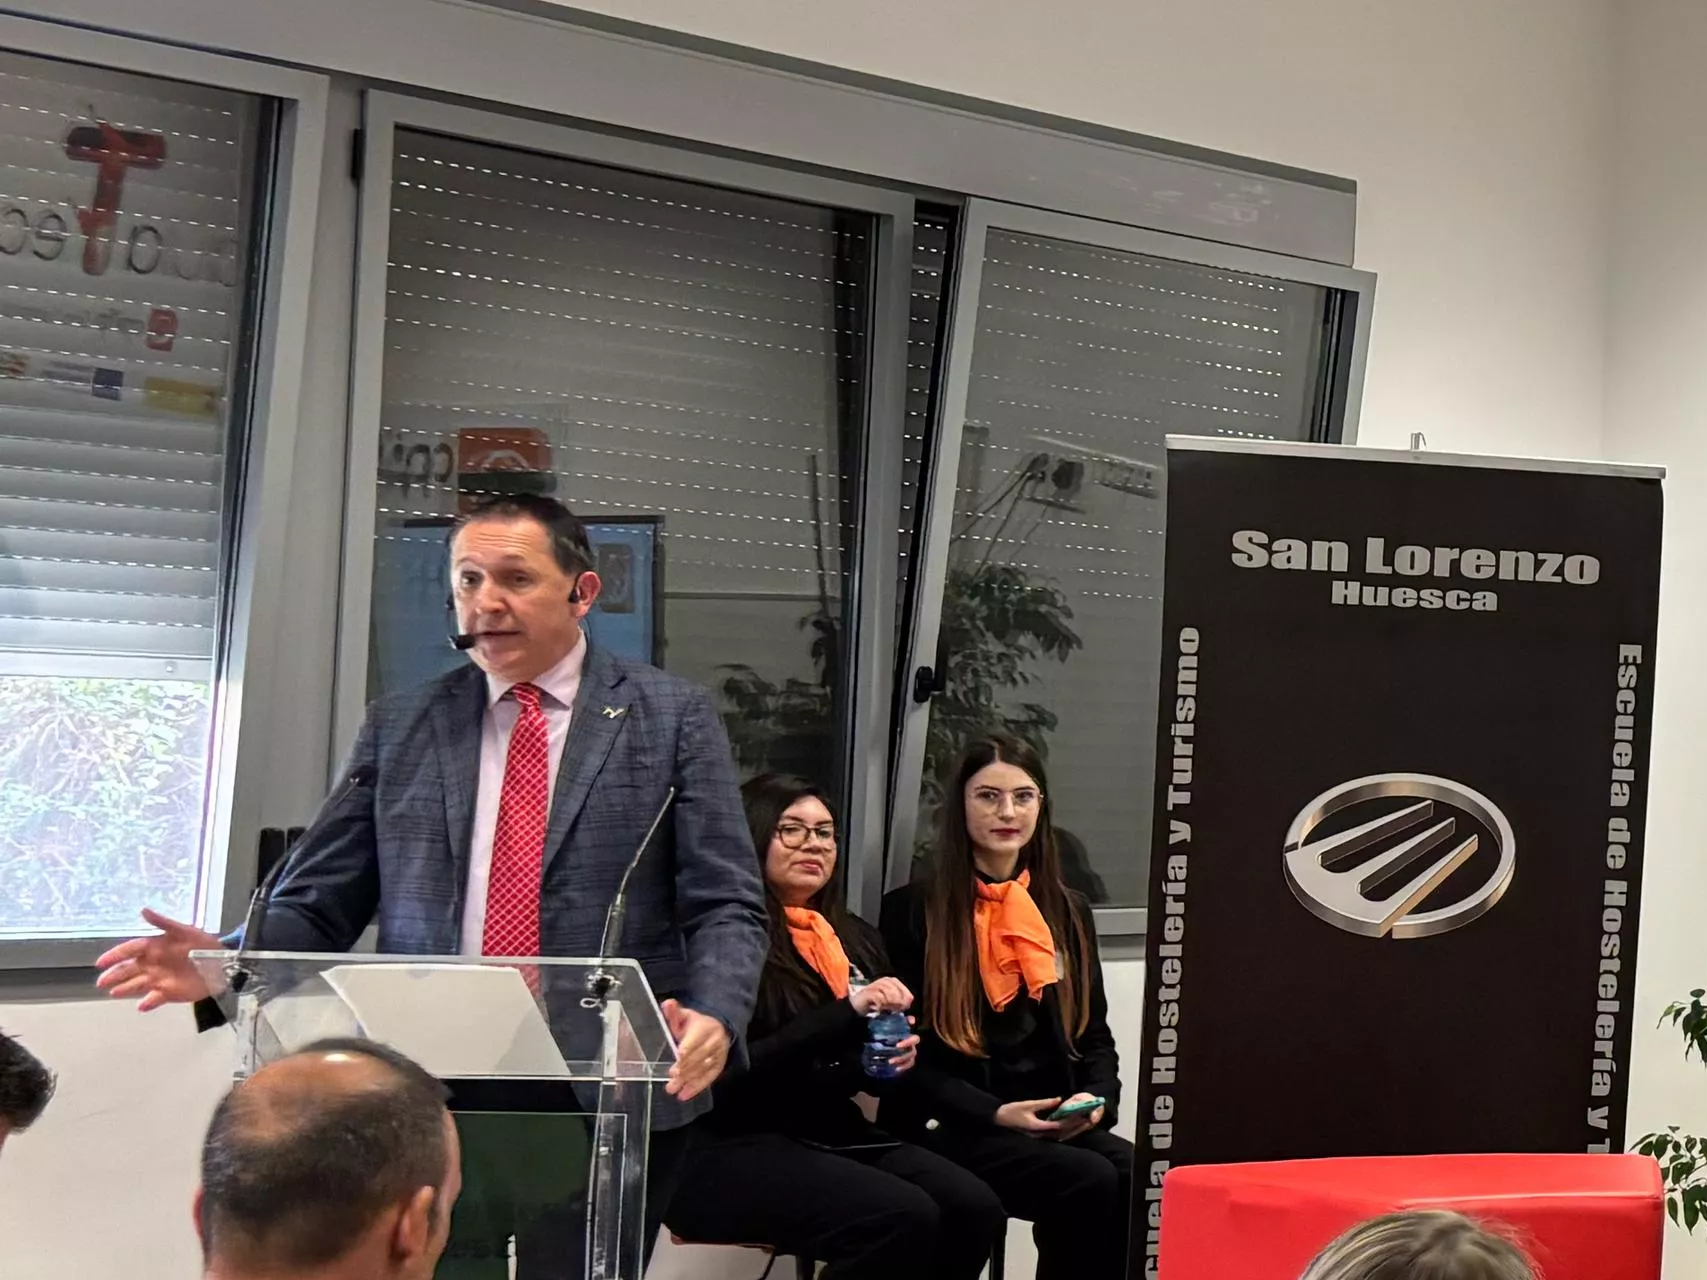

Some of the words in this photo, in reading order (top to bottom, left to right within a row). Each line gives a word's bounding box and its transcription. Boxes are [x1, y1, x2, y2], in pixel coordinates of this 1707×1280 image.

[1231, 529, 1349, 572] San
[1365, 536, 1600, 585] Lorenzo
[1331, 580, 1498, 612] Huesca
[1166, 627, 1200, 811] Turismo
[1609, 643, 1643, 808] Escuela
[1167, 822, 1192, 846] y
[1605, 817, 1632, 871] de
[1151, 854, 1190, 1084] Hostelería
[1588, 879, 1628, 1098] Hostelería
[1148, 1095, 1175, 1150] de
[1586, 1106, 1609, 1131] y
